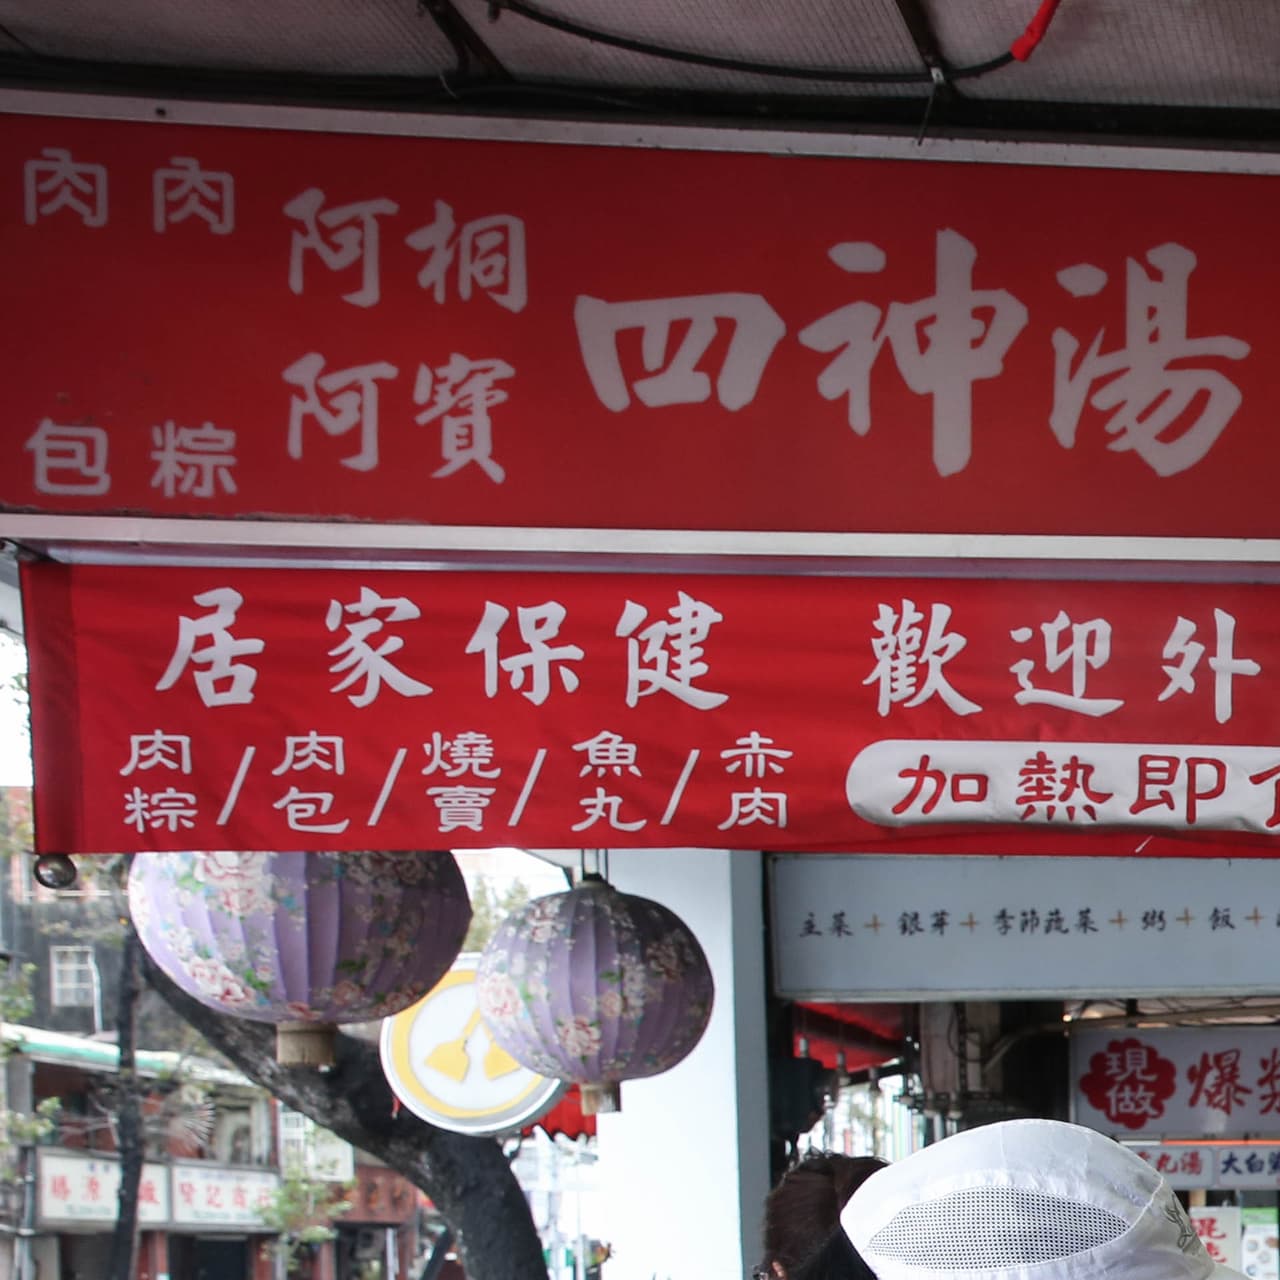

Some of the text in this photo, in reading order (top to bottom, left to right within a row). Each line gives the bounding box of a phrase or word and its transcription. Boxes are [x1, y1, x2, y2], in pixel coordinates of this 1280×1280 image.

[282, 187, 528, 314] 阿桐
[573, 226, 1252, 478] 四神湯
[281, 352, 517, 484] 阿寶
[155, 585, 730, 711] 居家保健
[1103, 1049, 1160, 1118] 現做
